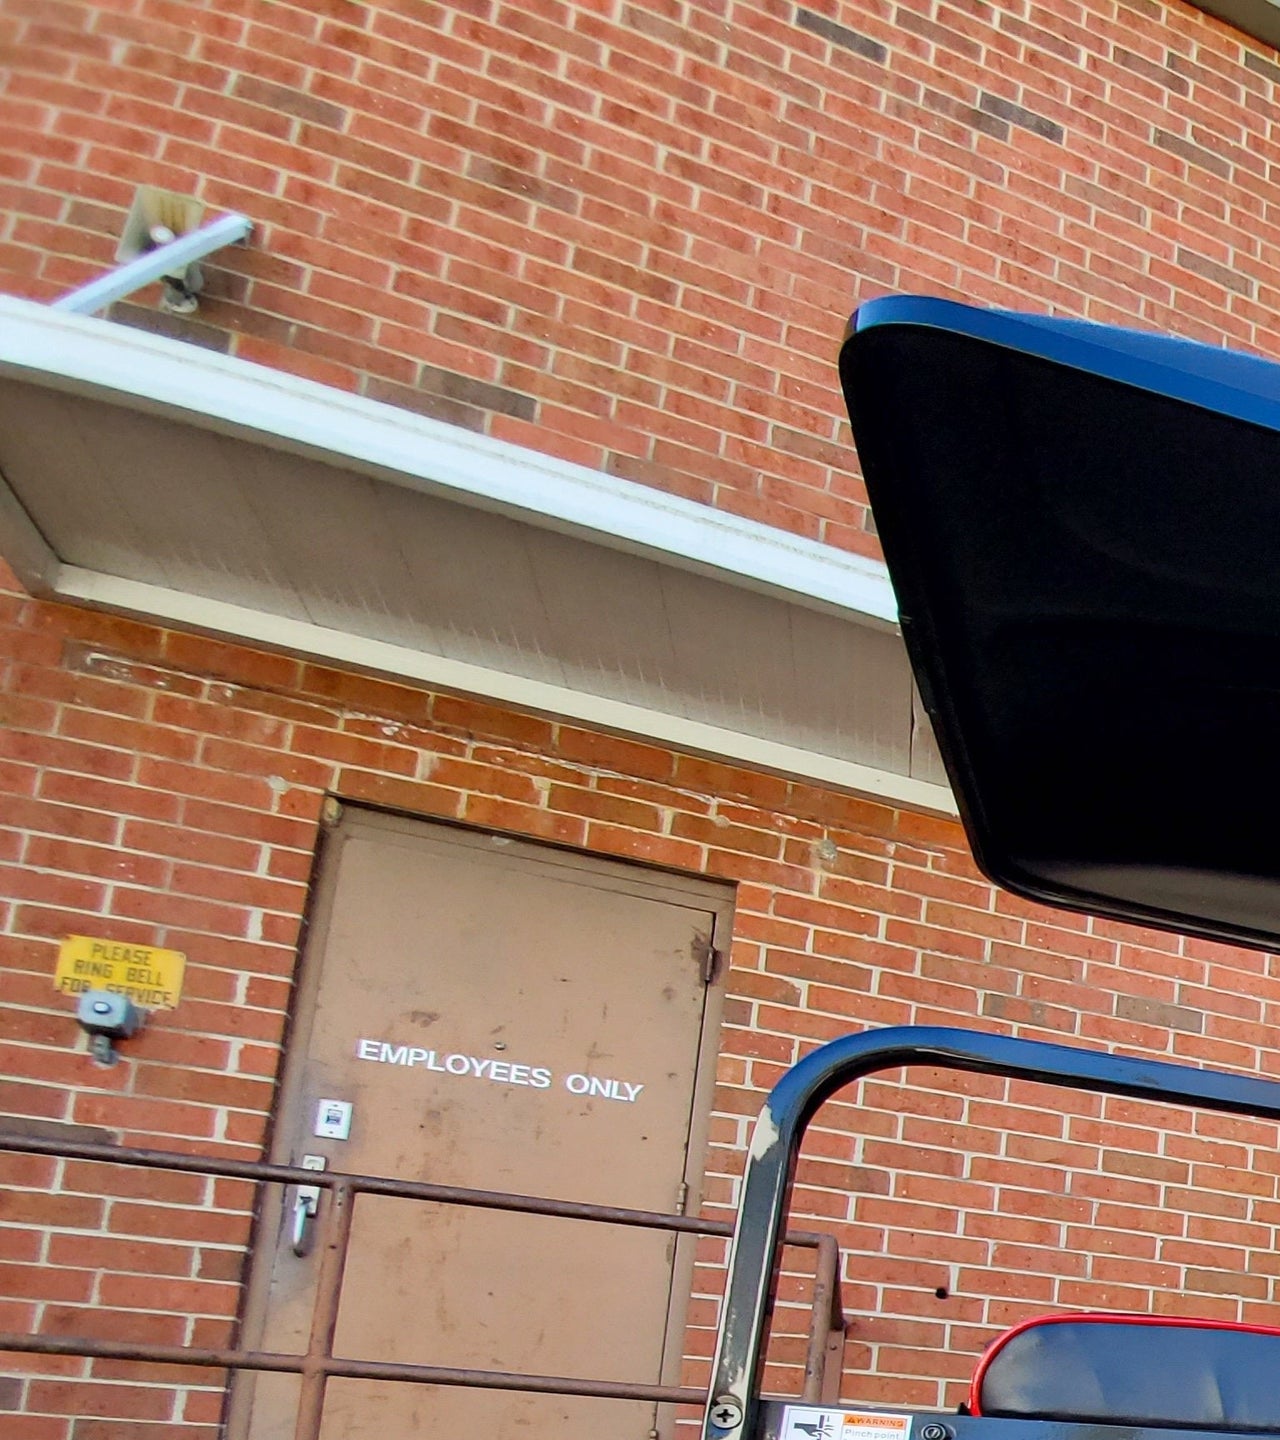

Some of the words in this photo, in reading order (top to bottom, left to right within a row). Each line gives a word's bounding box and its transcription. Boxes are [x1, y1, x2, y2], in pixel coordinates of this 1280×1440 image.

[92, 943, 153, 967] PLEASE
[74, 959, 114, 979] RING
[126, 967, 164, 986] BELL
[61, 976, 92, 993] FOR
[357, 1038, 552, 1088] EMPLOYEES
[565, 1073, 644, 1102] ONLY
[856, 1417, 904, 1427] WARNING
[845, 1428, 873, 1438] Pinch
